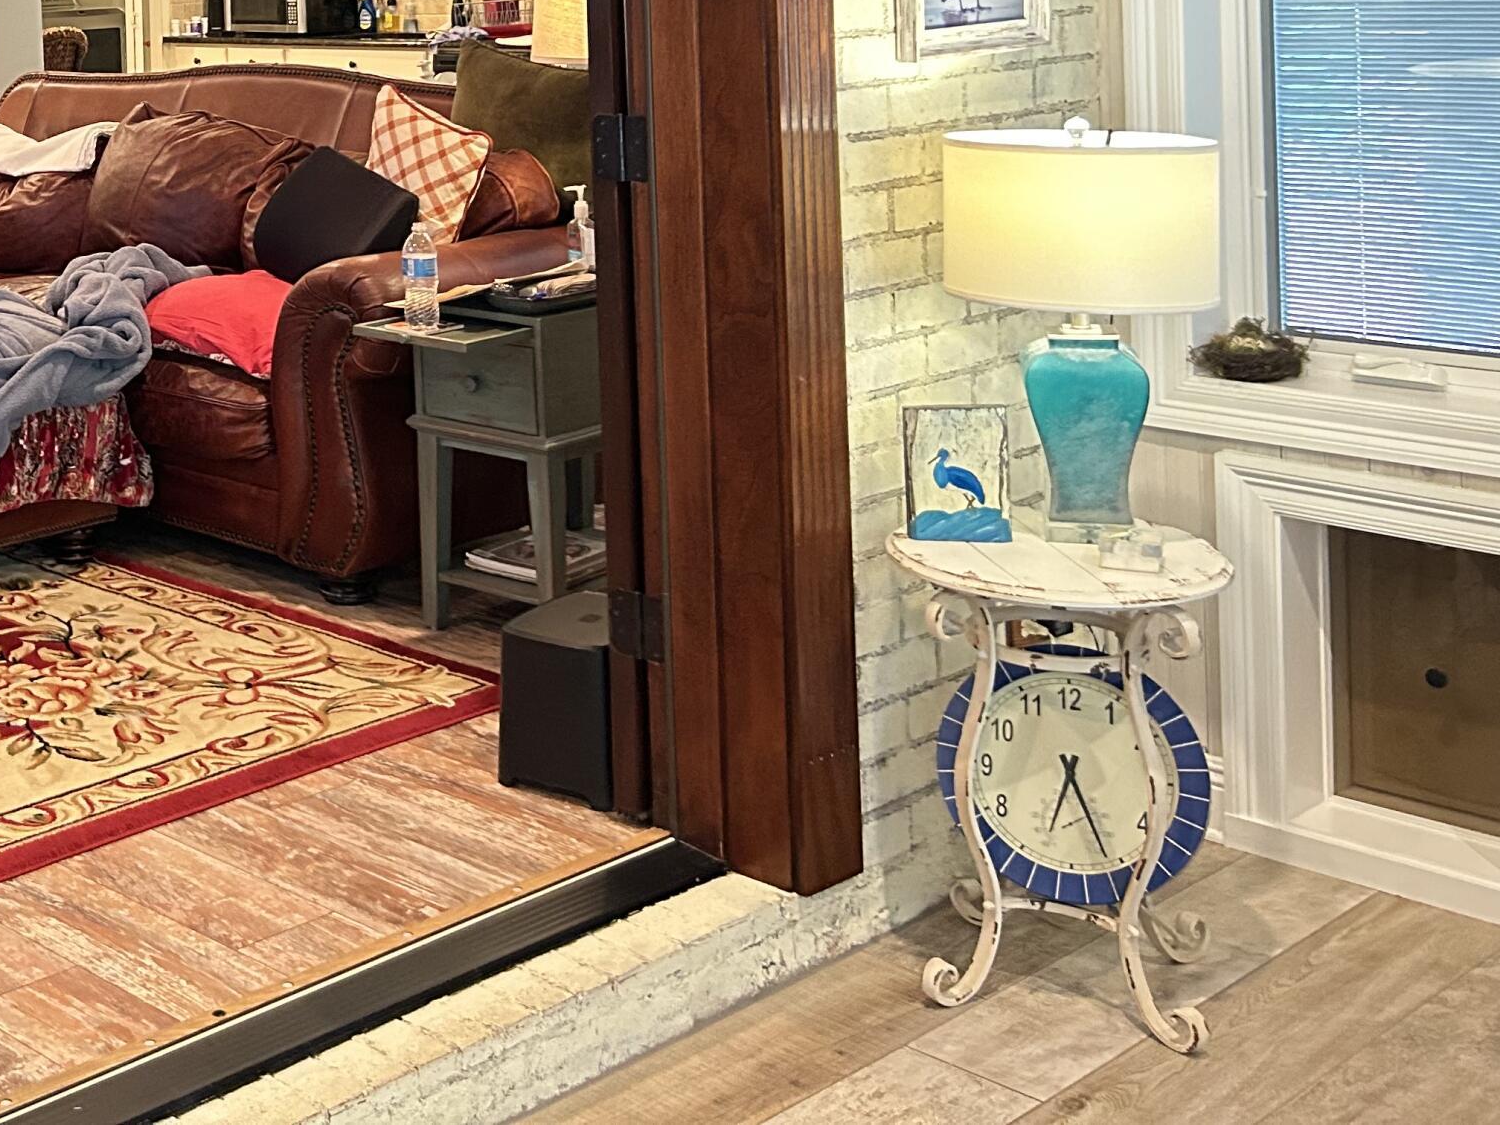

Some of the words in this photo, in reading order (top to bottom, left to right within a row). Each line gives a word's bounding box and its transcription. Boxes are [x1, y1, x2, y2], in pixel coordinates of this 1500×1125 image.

[1019, 693, 1042, 717] 11
[1057, 687, 1082, 712] 12
[1104, 701, 1116, 725] 1
[990, 718, 1014, 742] 10
[980, 753, 993, 777] 9
[996, 793, 1008, 818] 8
[1136, 811, 1149, 835] 4
